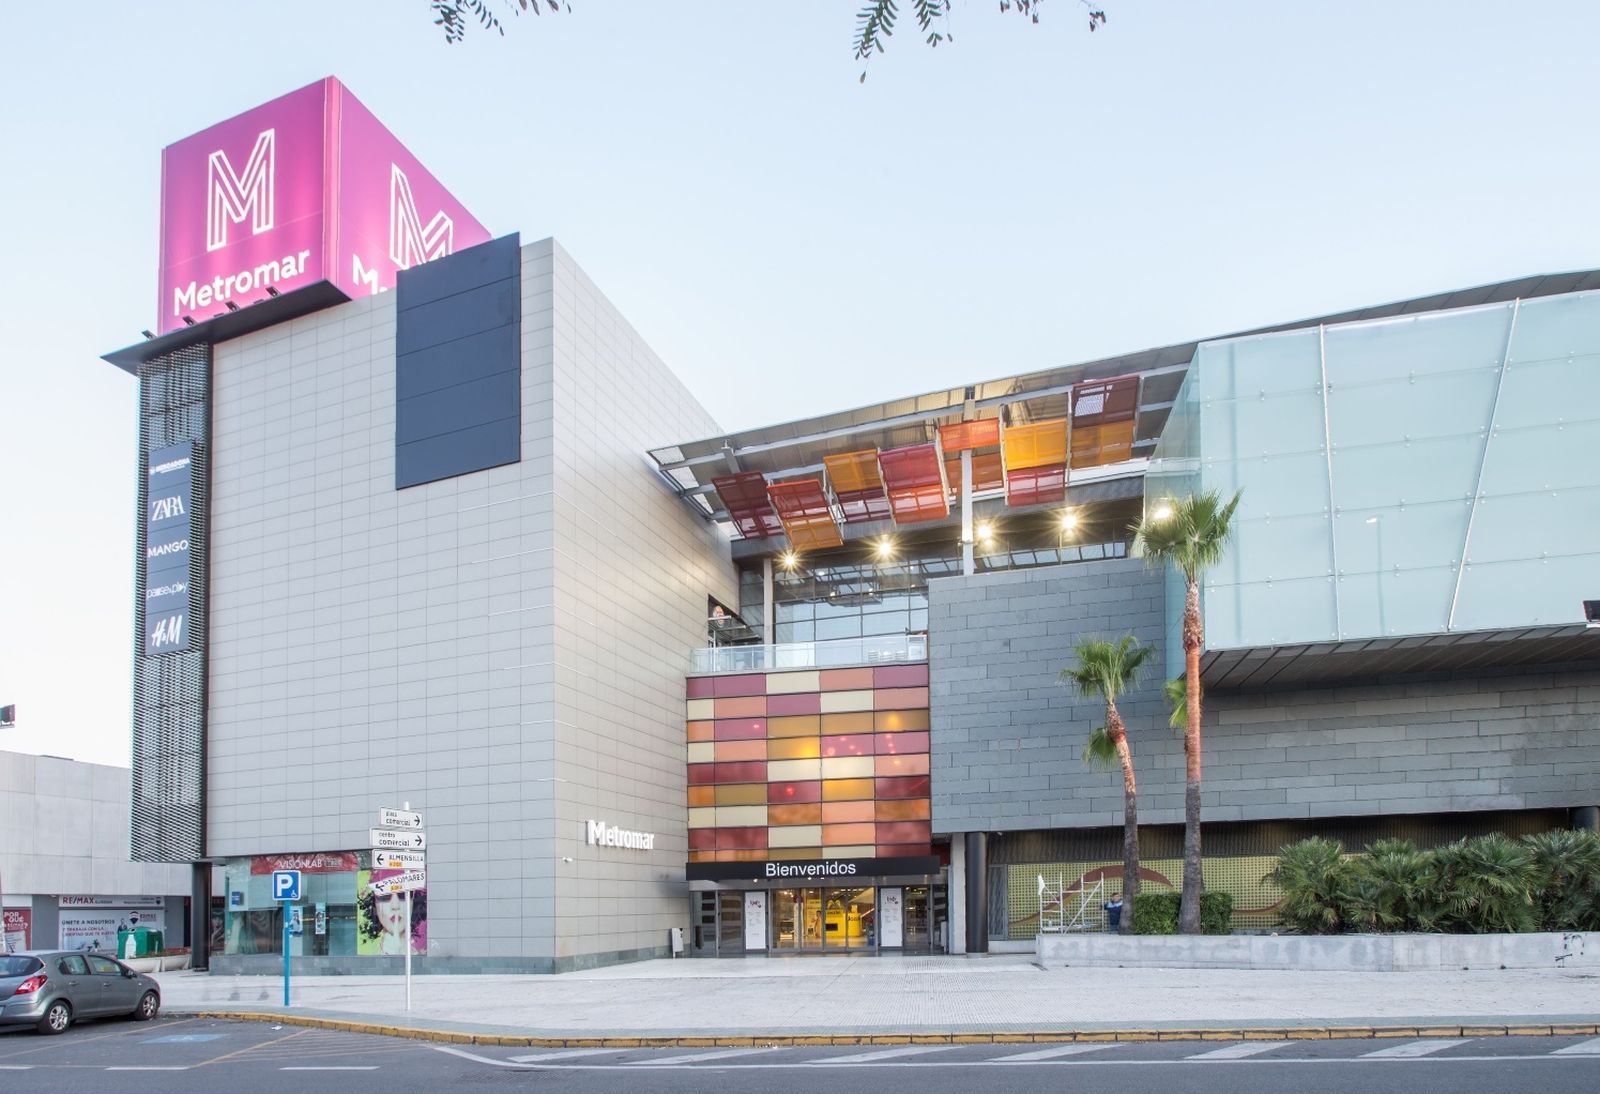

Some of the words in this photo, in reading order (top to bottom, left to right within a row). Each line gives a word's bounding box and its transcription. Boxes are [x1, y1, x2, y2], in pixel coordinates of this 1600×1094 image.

[207, 128, 275, 252] M
[173, 249, 310, 316] Metromar
[352, 253, 388, 296] M
[152, 495, 185, 522] ZARA
[148, 540, 188, 558] MANGO
[151, 615, 182, 647] H&M
[587, 820, 655, 850] Metromar
[279, 859, 322, 869] VISIONLAB
[765, 861, 856, 877] Bienvenidos
[276, 874, 294, 897] P
[63, 896, 95, 904] RE/MAX
